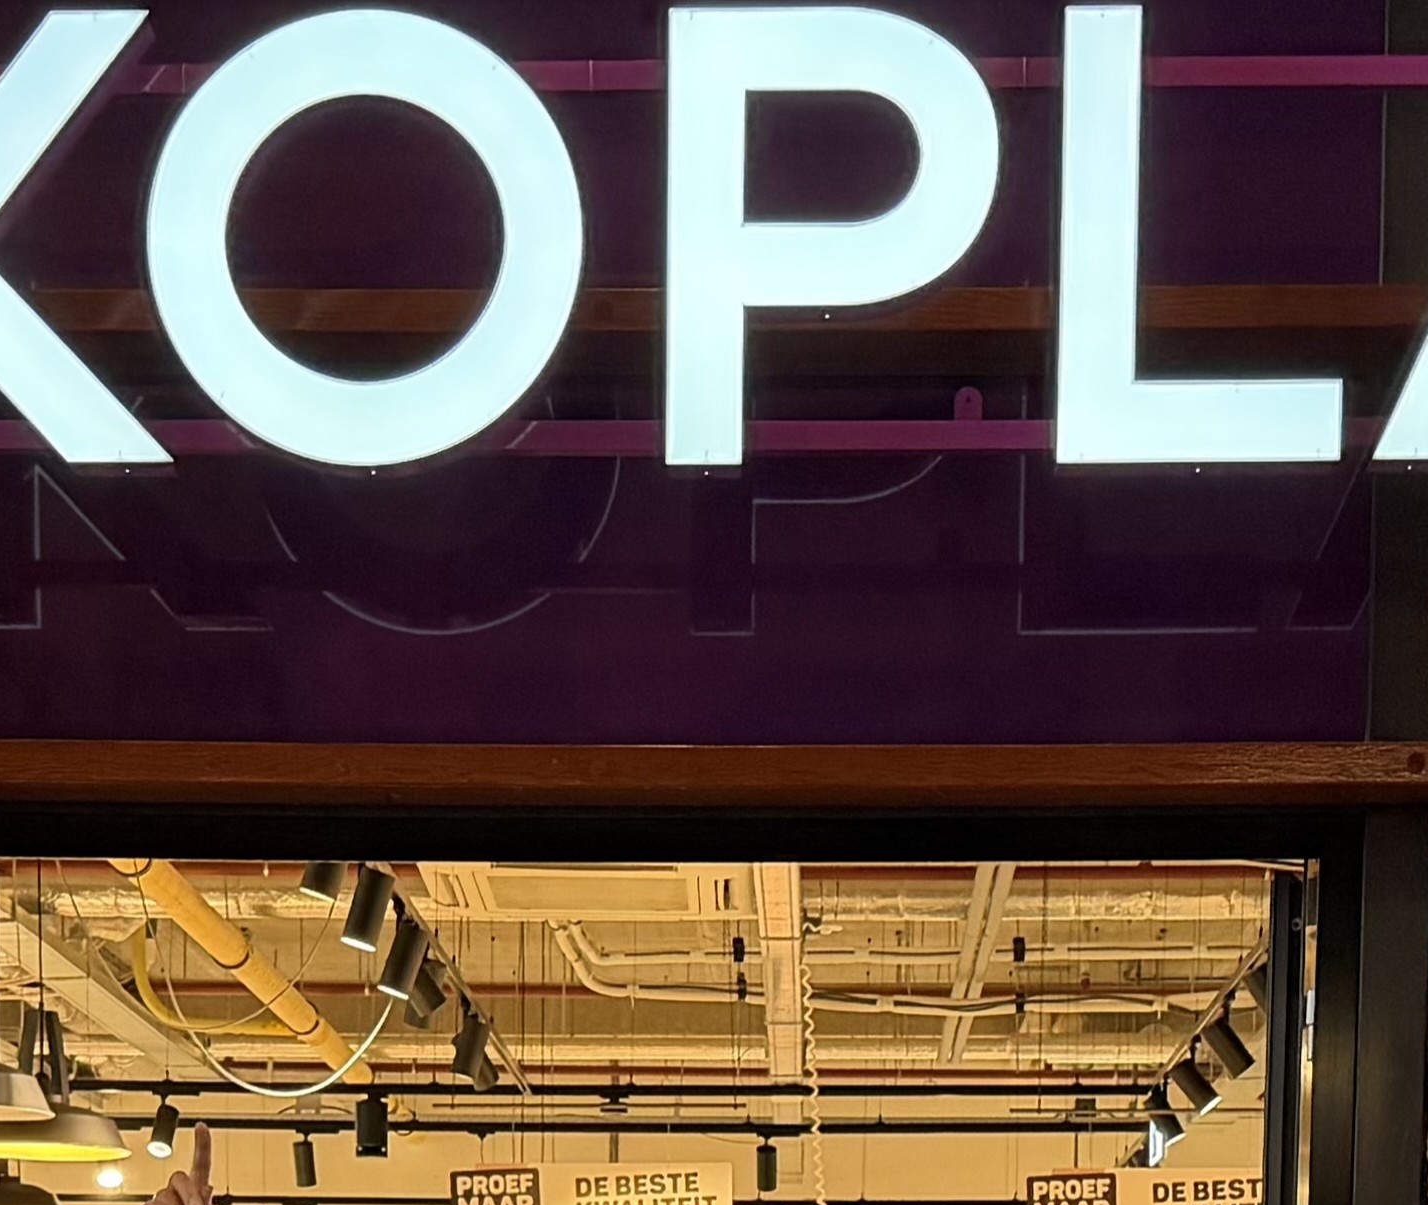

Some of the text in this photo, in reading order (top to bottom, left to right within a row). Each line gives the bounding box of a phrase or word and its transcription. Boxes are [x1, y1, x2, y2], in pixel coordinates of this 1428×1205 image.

[456, 1174, 534, 1196] PROEF
[575, 1172, 700, 1198] DE BESTE
[1032, 1178, 1112, 1201] PROEF
[1152, 1178, 1263, 1204] DE BEST
